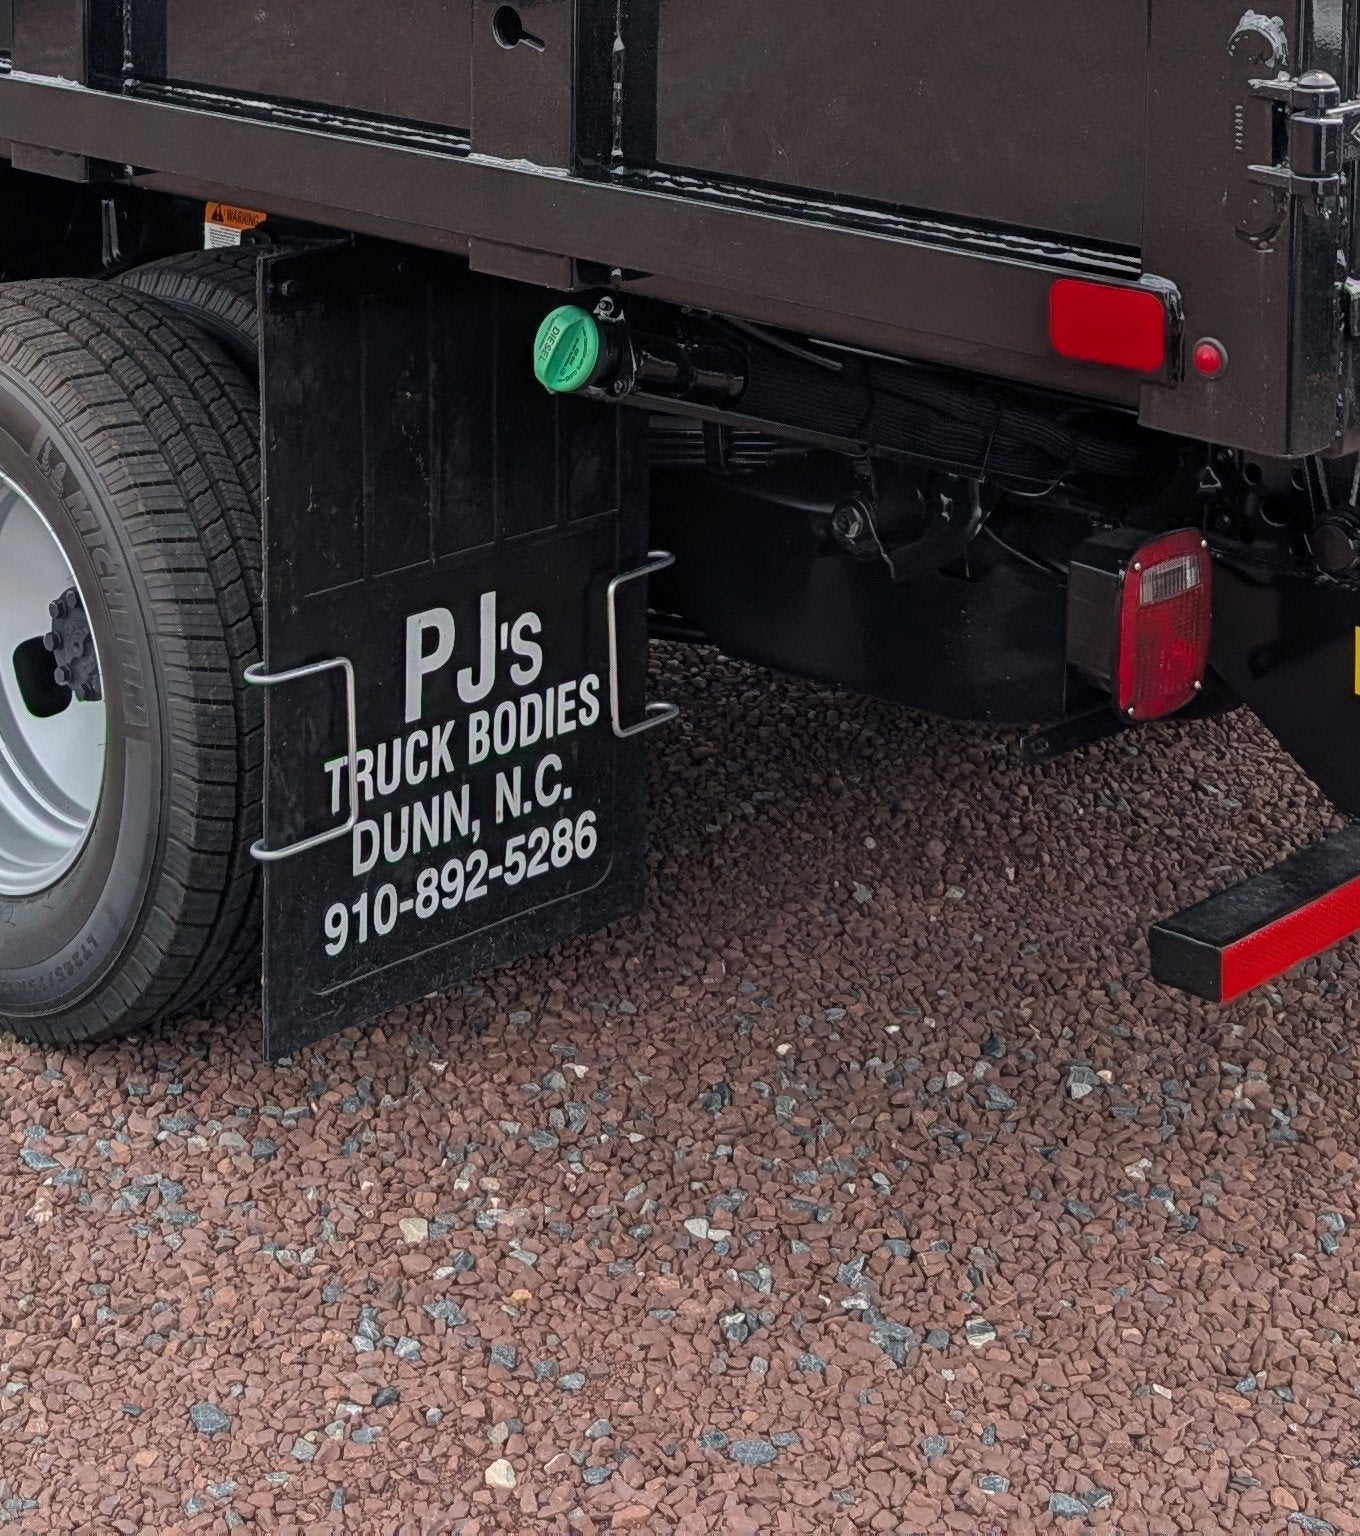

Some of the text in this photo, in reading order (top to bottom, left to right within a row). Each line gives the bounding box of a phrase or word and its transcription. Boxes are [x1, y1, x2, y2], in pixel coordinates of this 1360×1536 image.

[538, 325, 561, 362] DIESEL
[323, 673, 601, 816] TRUCK BODIES
[352, 753, 574, 878] DUNN, N.C.
[323, 809, 598, 957] 910-892-5286
